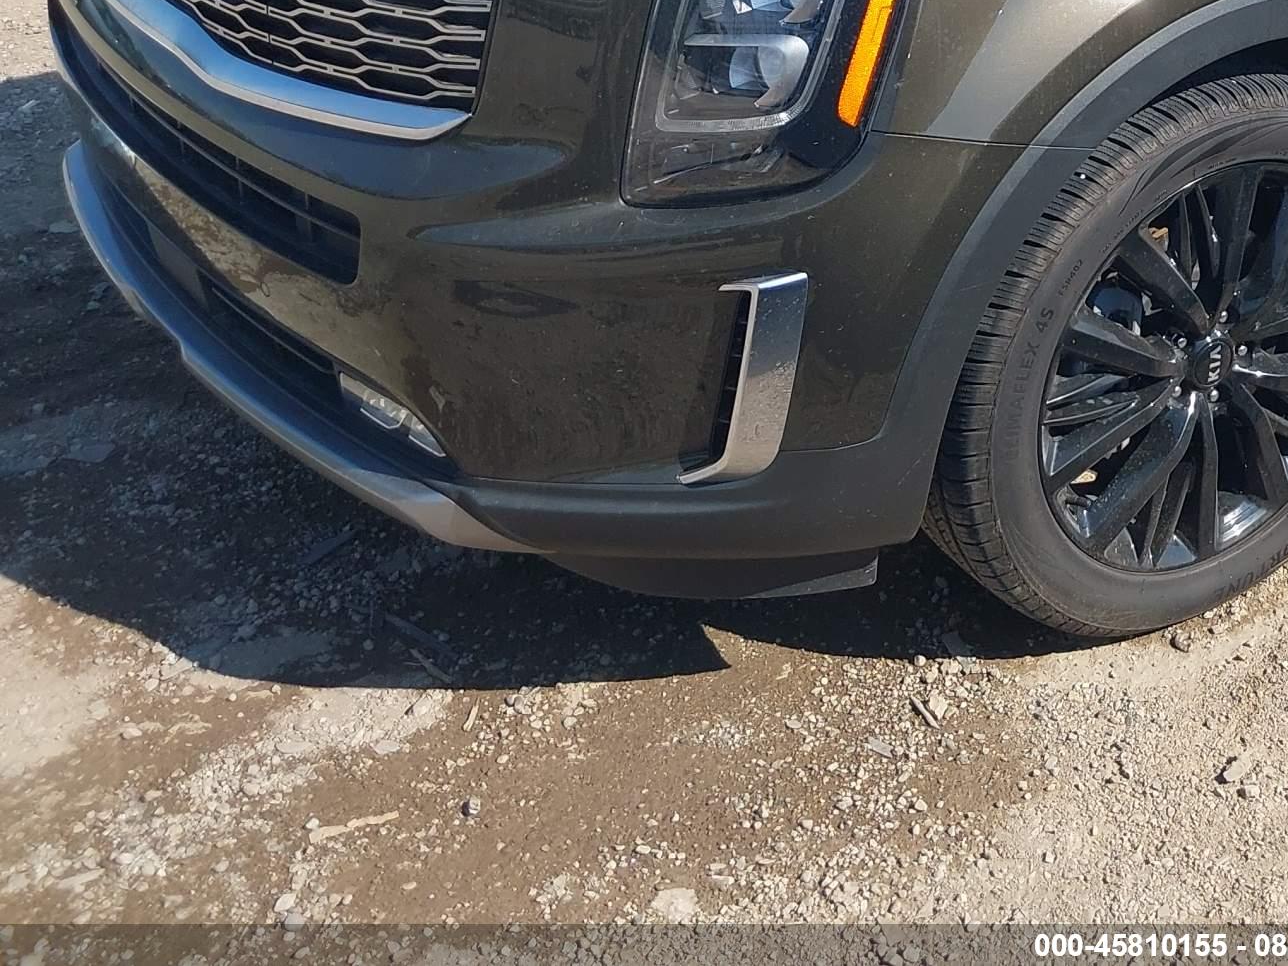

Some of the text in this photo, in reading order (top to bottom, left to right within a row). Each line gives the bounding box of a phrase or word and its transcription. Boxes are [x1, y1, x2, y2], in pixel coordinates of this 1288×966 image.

[1001, 307, 1054, 465] LIMAFLEX 4S
[1207, 344, 1222, 383] KIA
